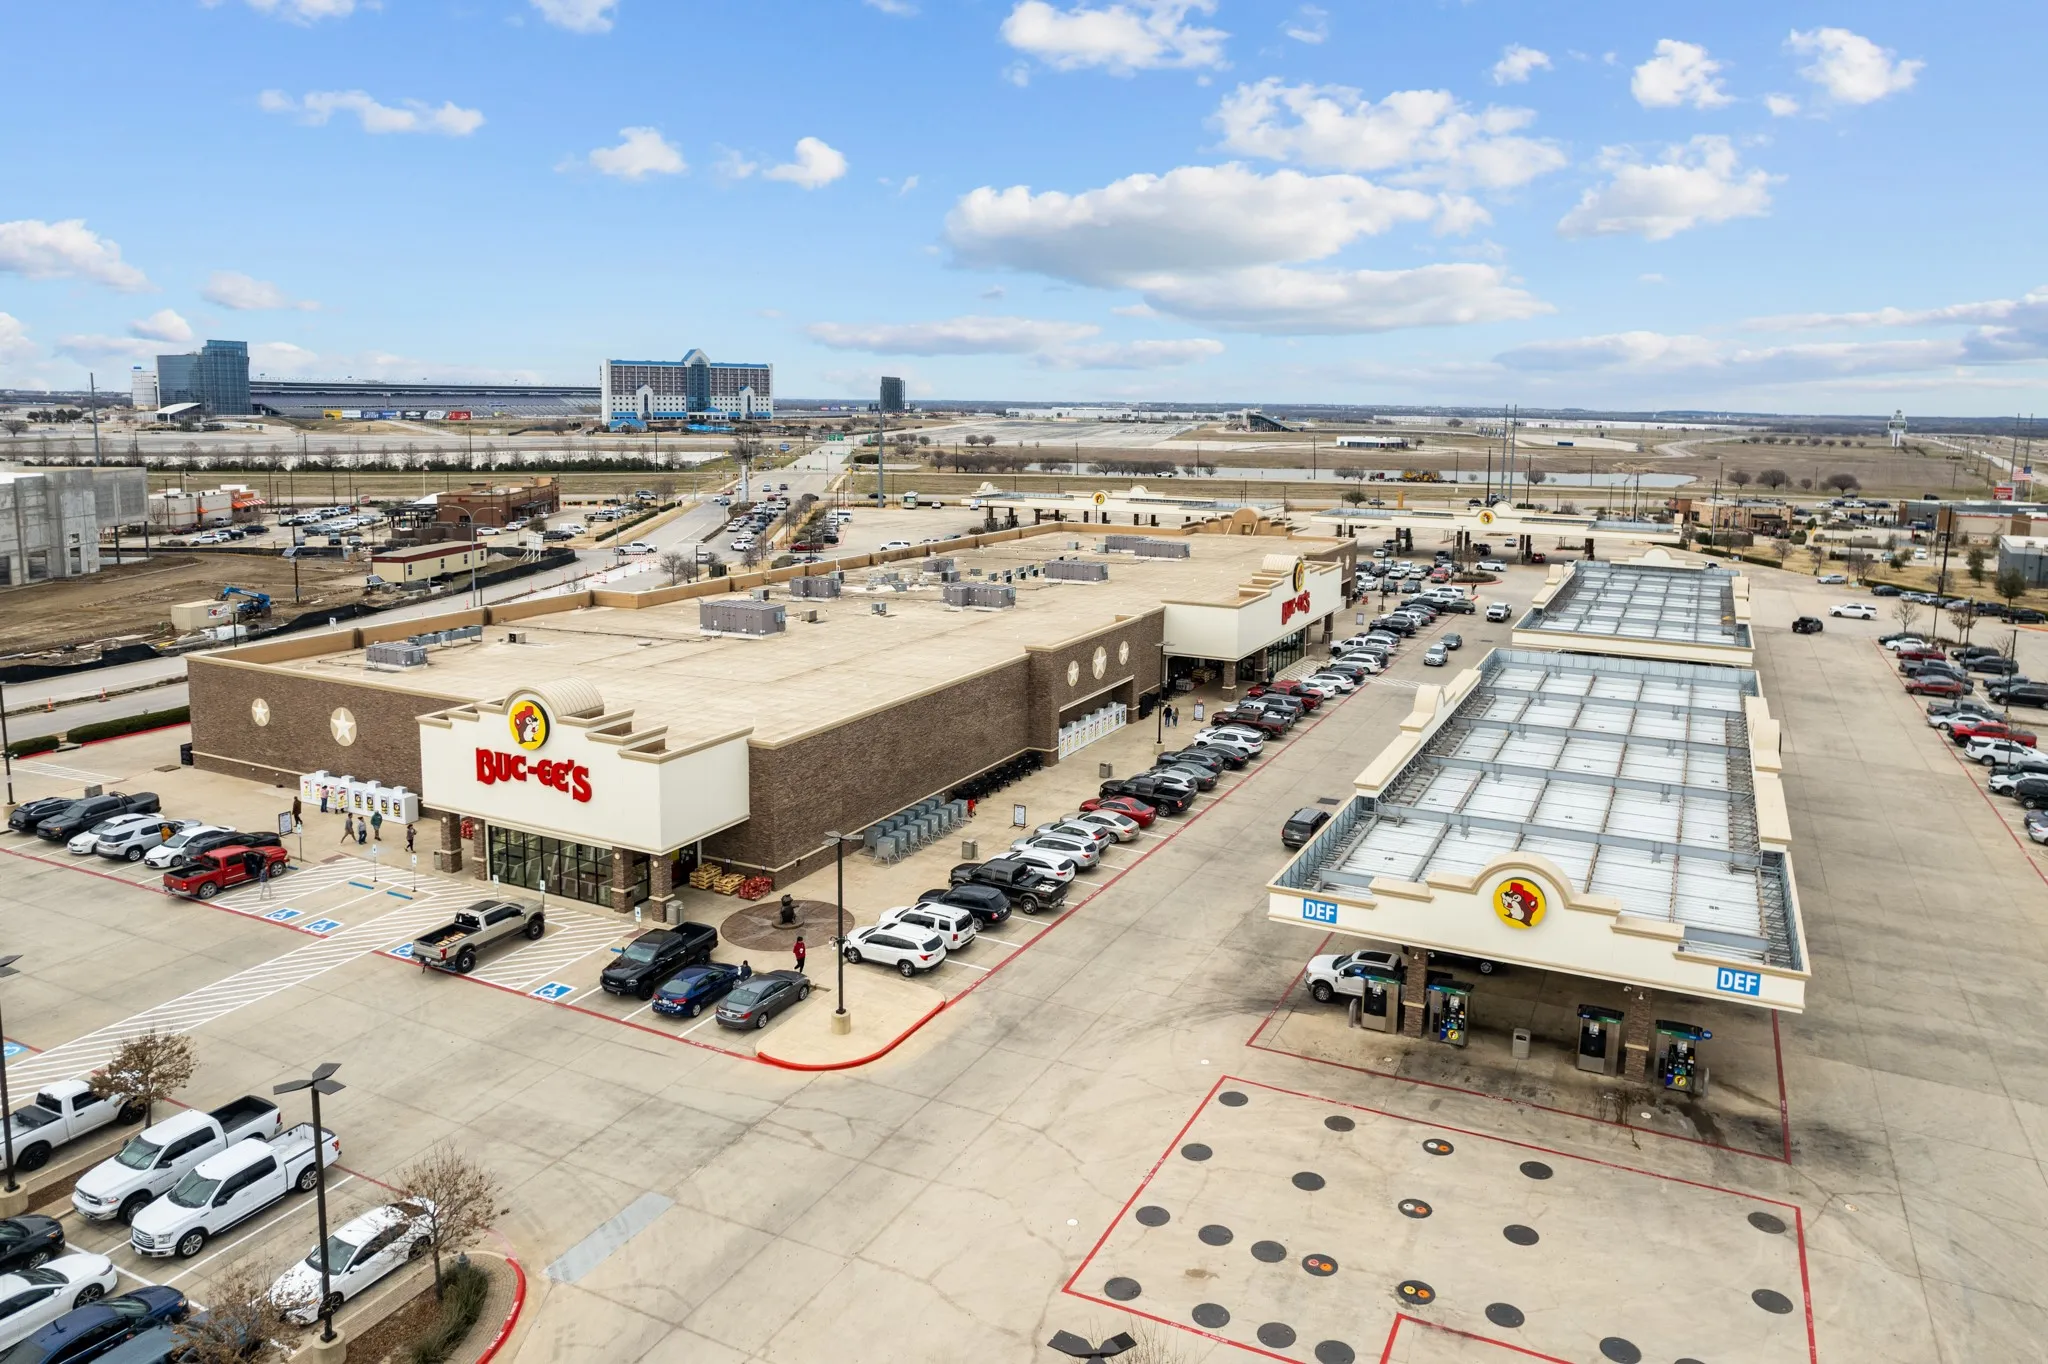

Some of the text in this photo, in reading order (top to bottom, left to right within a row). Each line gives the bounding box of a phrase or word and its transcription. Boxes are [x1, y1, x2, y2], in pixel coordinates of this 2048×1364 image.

[475, 747, 593, 803] BUC-EE'S
[1305, 901, 1336, 921] DEF
[1719, 970, 1758, 993] DEF
